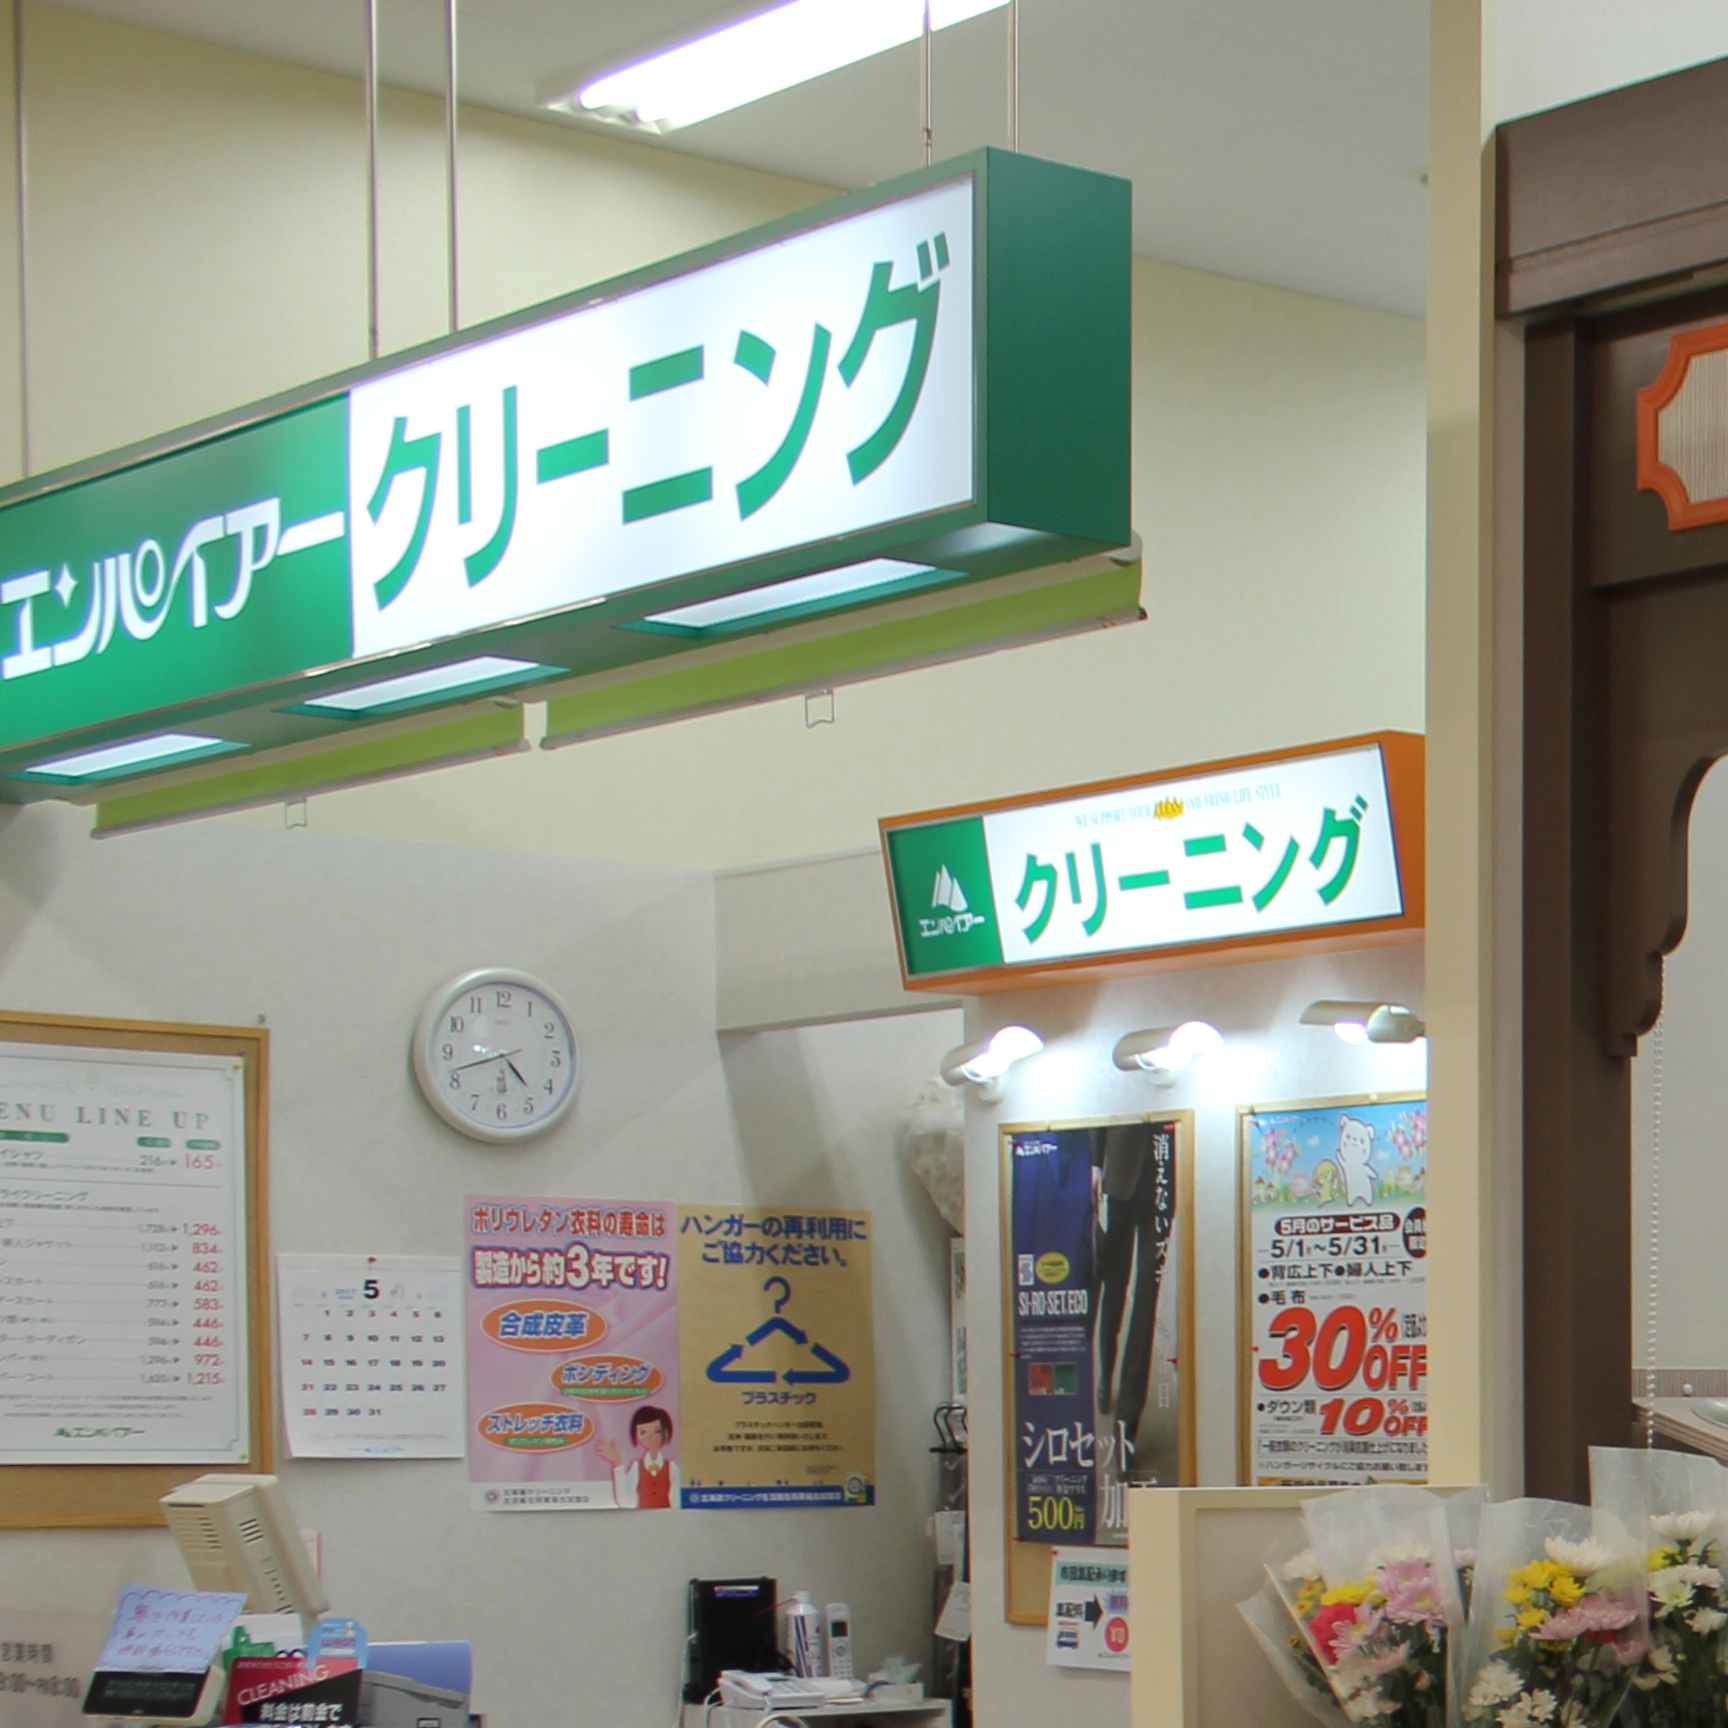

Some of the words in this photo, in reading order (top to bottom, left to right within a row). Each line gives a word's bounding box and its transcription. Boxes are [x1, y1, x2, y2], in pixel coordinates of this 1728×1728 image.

[365, 232, 952, 611] クリーニング
[2, 497, 345, 682] エンパイアー
[1091, 808, 1126, 827] SUPPORT
[1128, 804, 1151, 819] YOUR
[1205, 791, 1232, 808] FRESH
[1233, 786, 1253, 801] LIFE
[1255, 782, 1283, 799] STYLE
[1015, 792, 1369, 943] クリーニング
[918, 911, 985, 938] エンパイアー
[470, 997, 481, 1013] 11
[496, 991, 511, 1008] 12
[527, 1001, 532, 1017] 1
[451, 1016, 464, 1032] 10
[544, 1022, 554, 1039] 2
[442, 1044, 453, 1060] 9
[551, 1050, 560, 1067] 3
[450, 1072, 460, 1089] 8
[544, 1079, 553, 1094] 4
[471, 1094, 479, 1111] 7
[496, 1103, 507, 1120] 6
[523, 1097, 533, 1114] 5
[76, 1105, 153, 1127] LINE
[173, 1110, 210, 1130] UP
[185, 1154, 214, 1170] 165
[473, 1205, 666, 1237] ポリウレタン衣料の寿命は
[680, 1214, 867, 1240] ハンガーの再利用に
[1280, 1213, 1394, 1235] 5月のサービス品
[702, 1240, 847, 1267] ご協力ください。
[474, 1243, 669, 1289] 製造から約3年です!
[1271, 1263, 1334, 1279] 背広上下
[363, 1279, 380, 1300] 5
[500, 1311, 588, 1338] 合成皮革
[741, 1391, 817, 1405] プラスチック
[487, 1412, 585, 1434] ストレッチ衣料
[1022, 1420, 1136, 1472] シロセット
[237, 1664, 330, 1706] CLEANING
[260, 1702, 343, 1721] 料金は前金で
